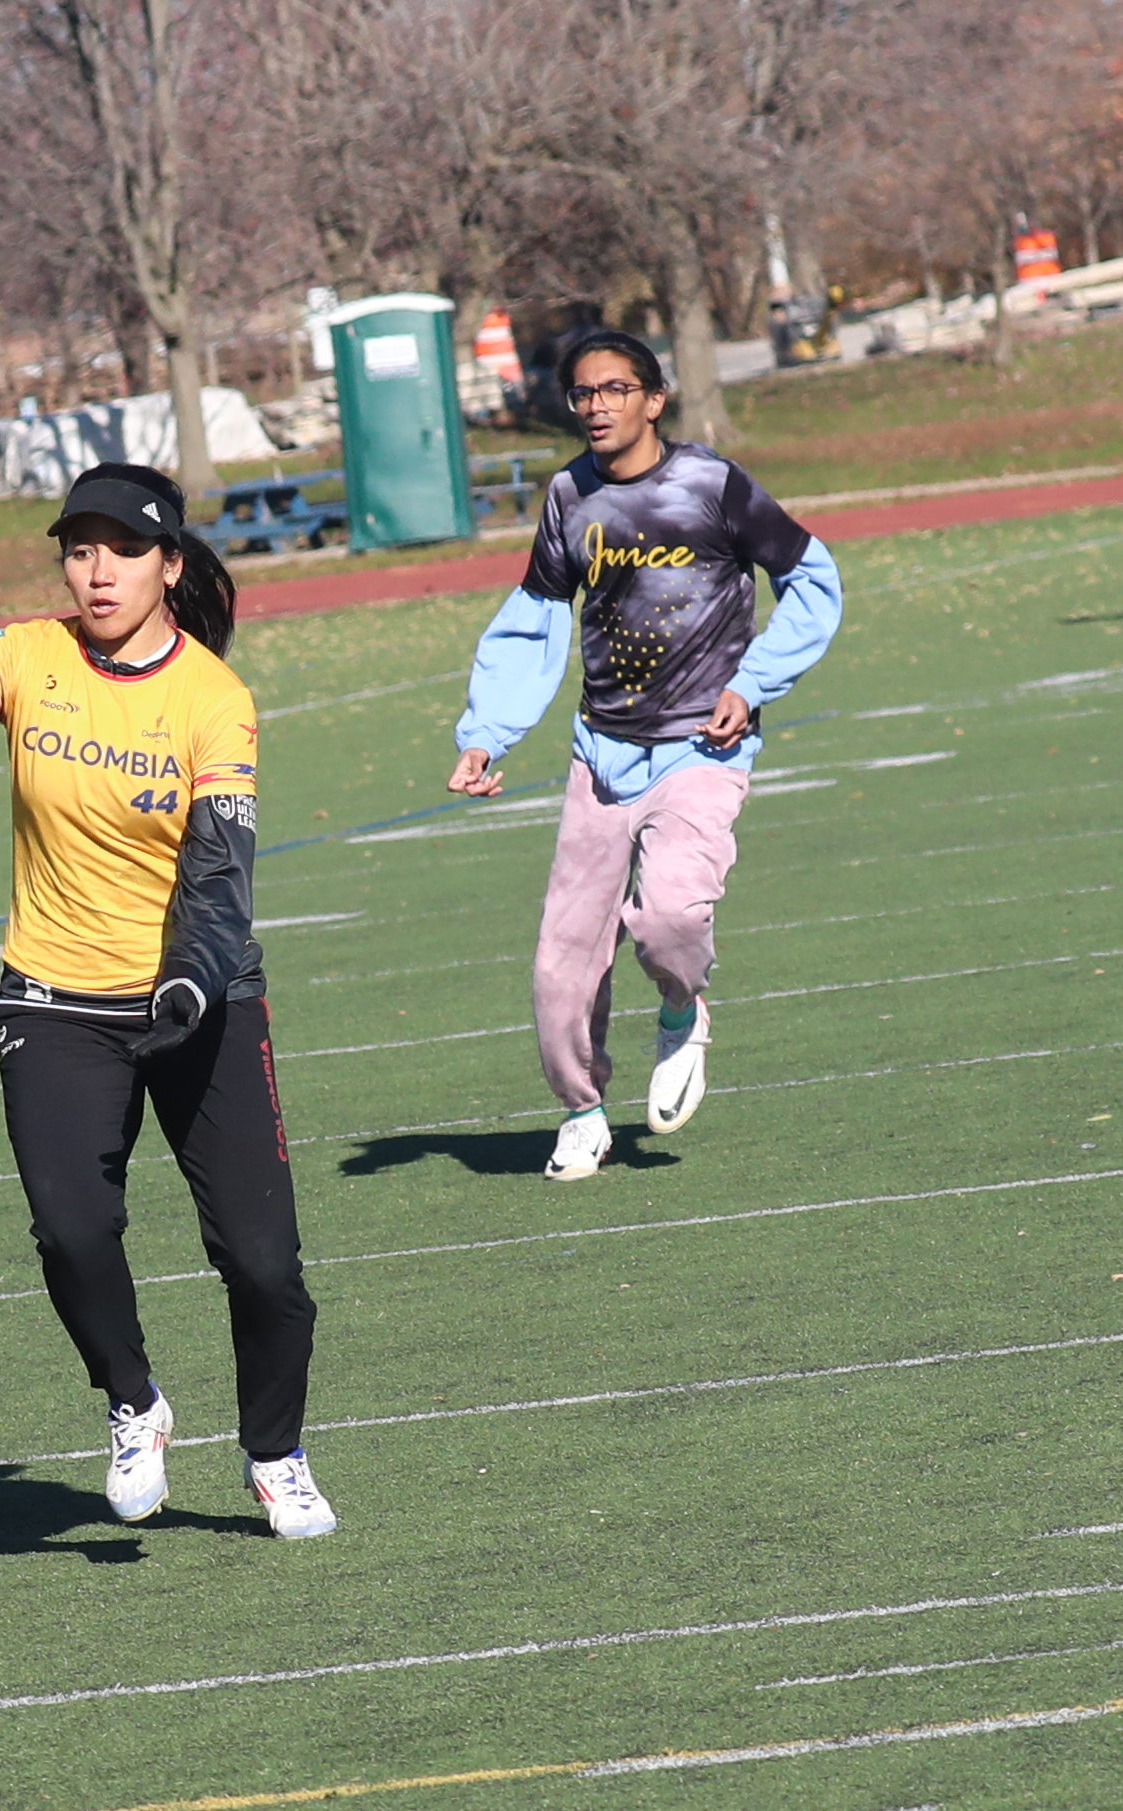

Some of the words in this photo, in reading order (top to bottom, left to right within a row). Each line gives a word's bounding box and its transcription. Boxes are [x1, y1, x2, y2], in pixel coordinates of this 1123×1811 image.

[584, 522, 695, 588] Juice
[22, 726, 181, 779] COLOMBIA
[130, 788, 179, 814] 44
